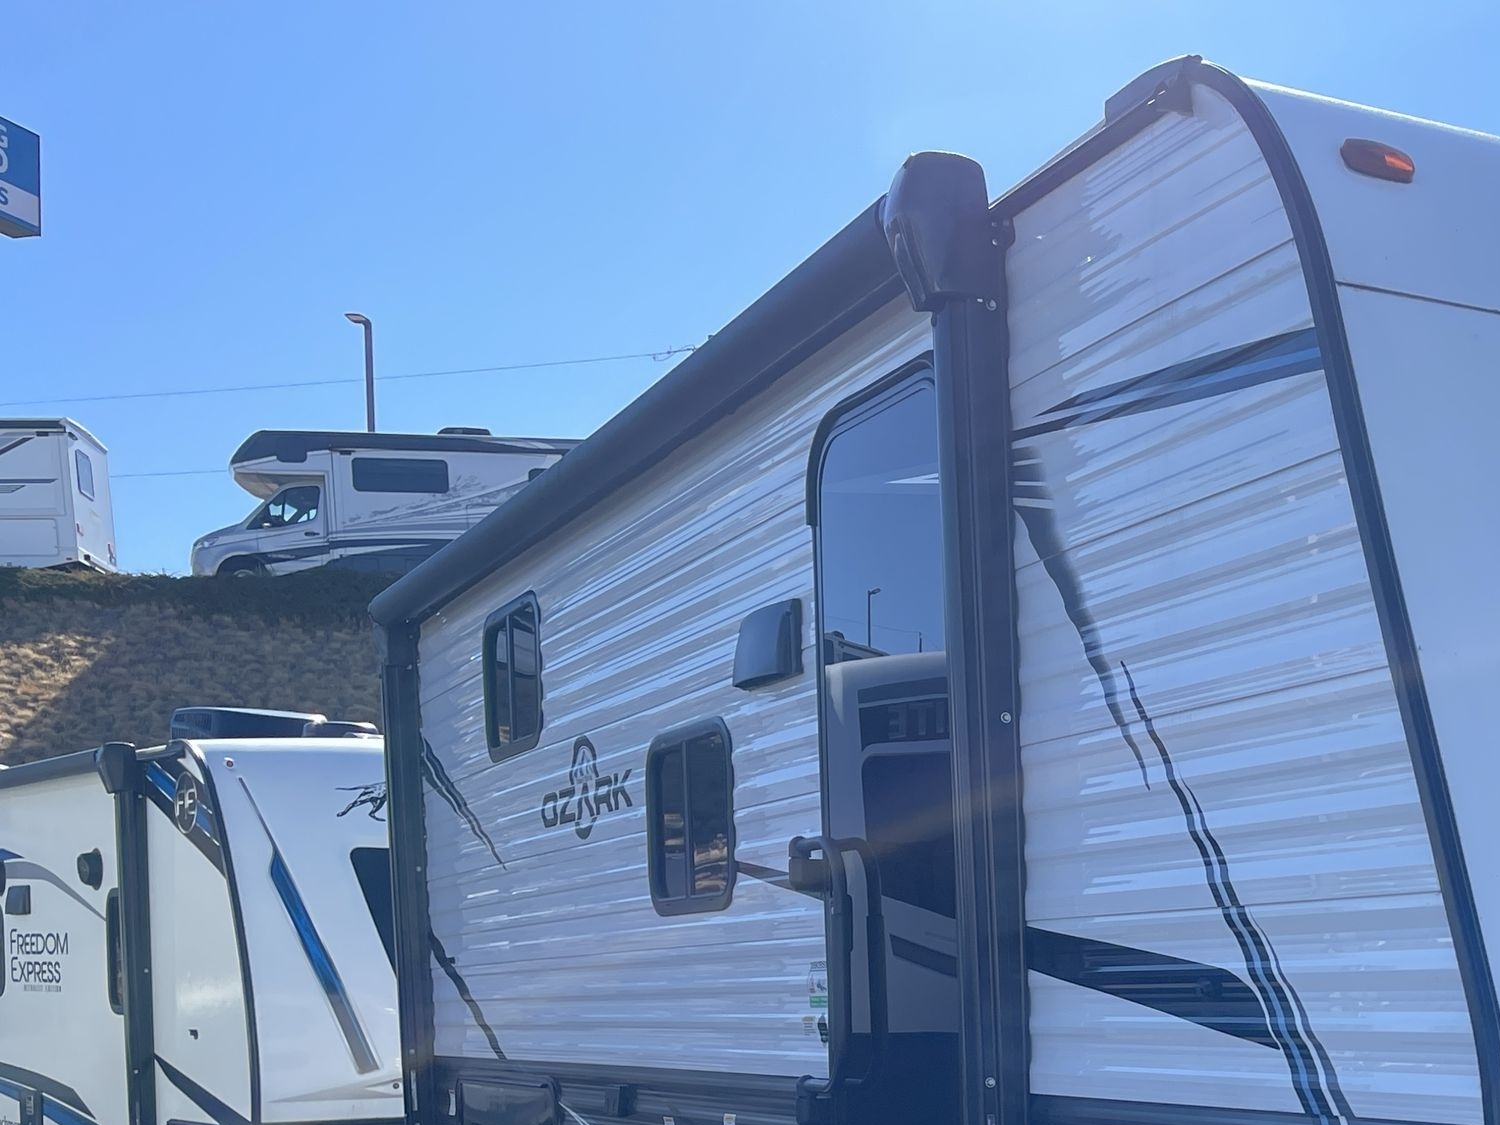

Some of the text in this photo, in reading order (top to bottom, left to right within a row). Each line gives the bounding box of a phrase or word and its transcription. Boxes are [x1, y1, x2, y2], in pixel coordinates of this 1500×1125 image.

[541, 768, 633, 829] OZARK
[10, 928, 69, 955] FREEDOM
[11, 956, 61, 983] EXPRESS
